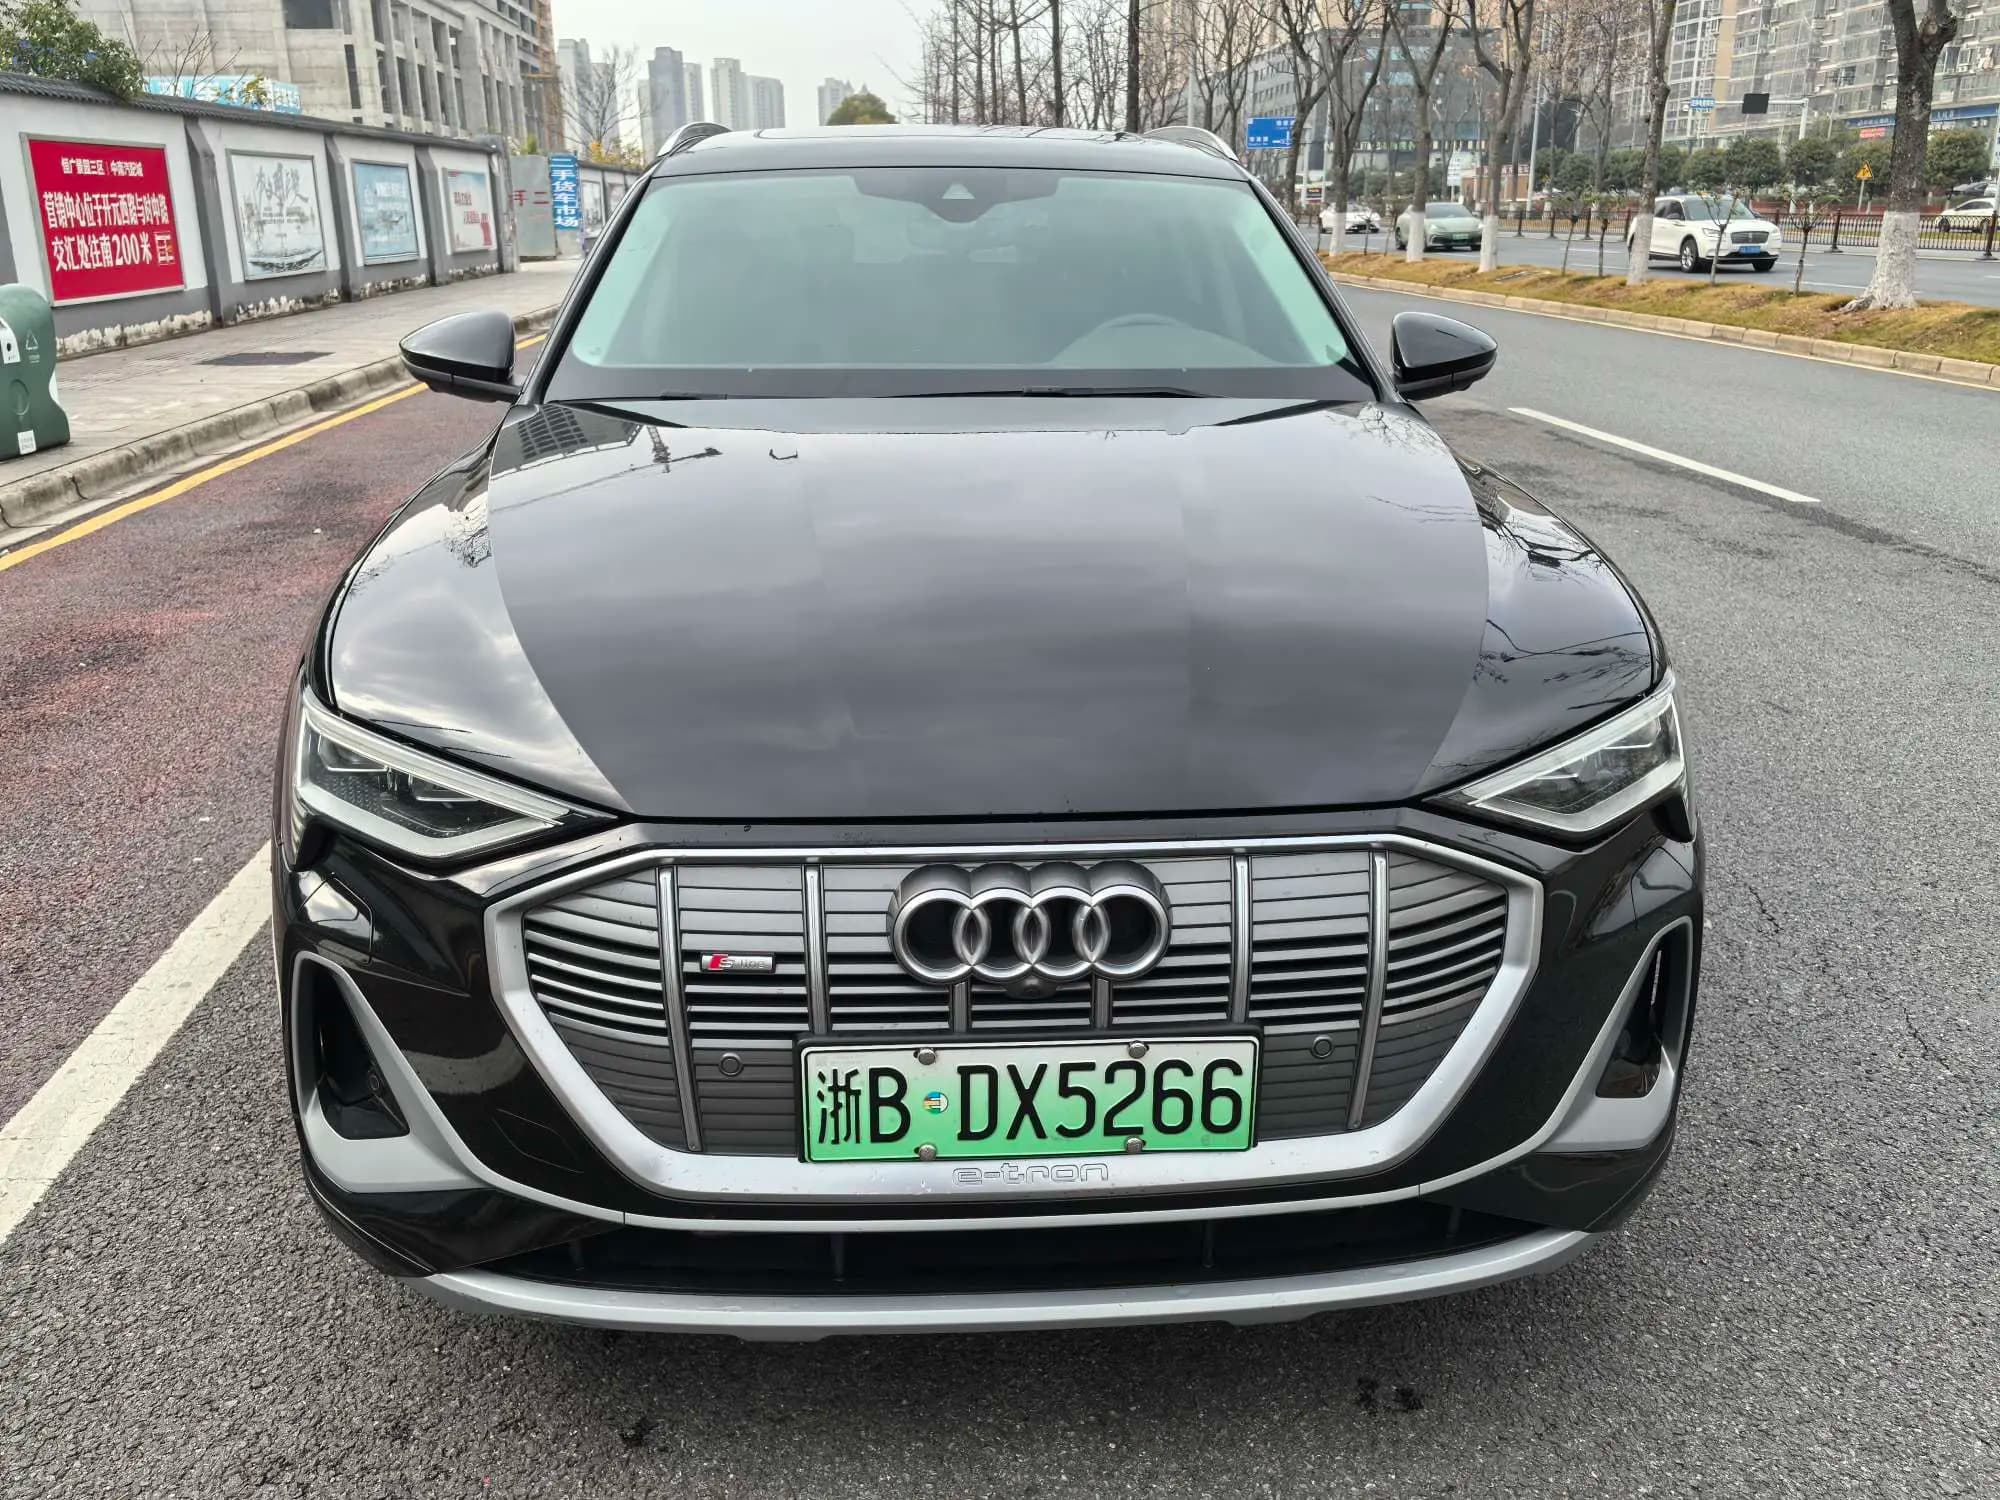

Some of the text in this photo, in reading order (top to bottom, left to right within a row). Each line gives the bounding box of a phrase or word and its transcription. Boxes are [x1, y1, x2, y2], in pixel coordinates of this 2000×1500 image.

[549, 157, 579, 228] 二手货车市场
[51, 231, 153, 271] 交汇处往南200米
[952, 1162, 1109, 1186] e-tron
